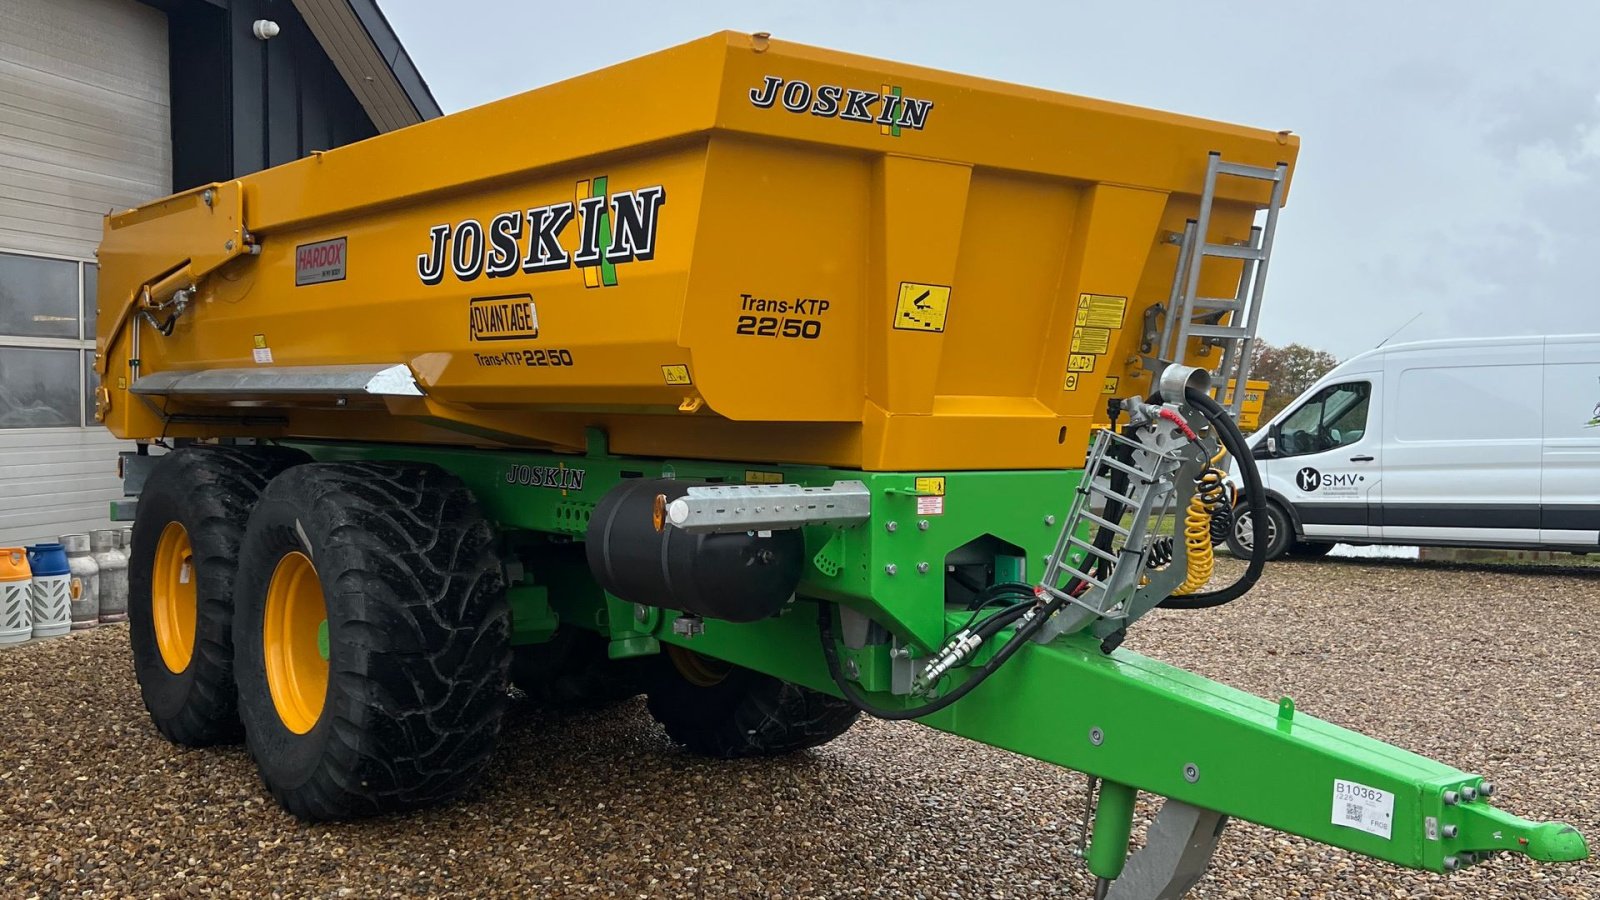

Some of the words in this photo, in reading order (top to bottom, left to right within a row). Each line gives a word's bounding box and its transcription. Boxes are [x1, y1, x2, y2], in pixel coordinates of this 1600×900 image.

[749, 75, 934, 131] JOSKIN
[417, 185, 666, 286] JOSKIN
[740, 293, 830, 316] Trans-KTP
[470, 303, 533, 341] ADVANTAGE
[736, 315, 822, 340] 22/50
[473, 352, 522, 367] Trans-KTP
[522, 349, 574, 368] 22/50
[505, 464, 586, 491] JOSKIN
[1336, 782, 1383, 803] B10362
